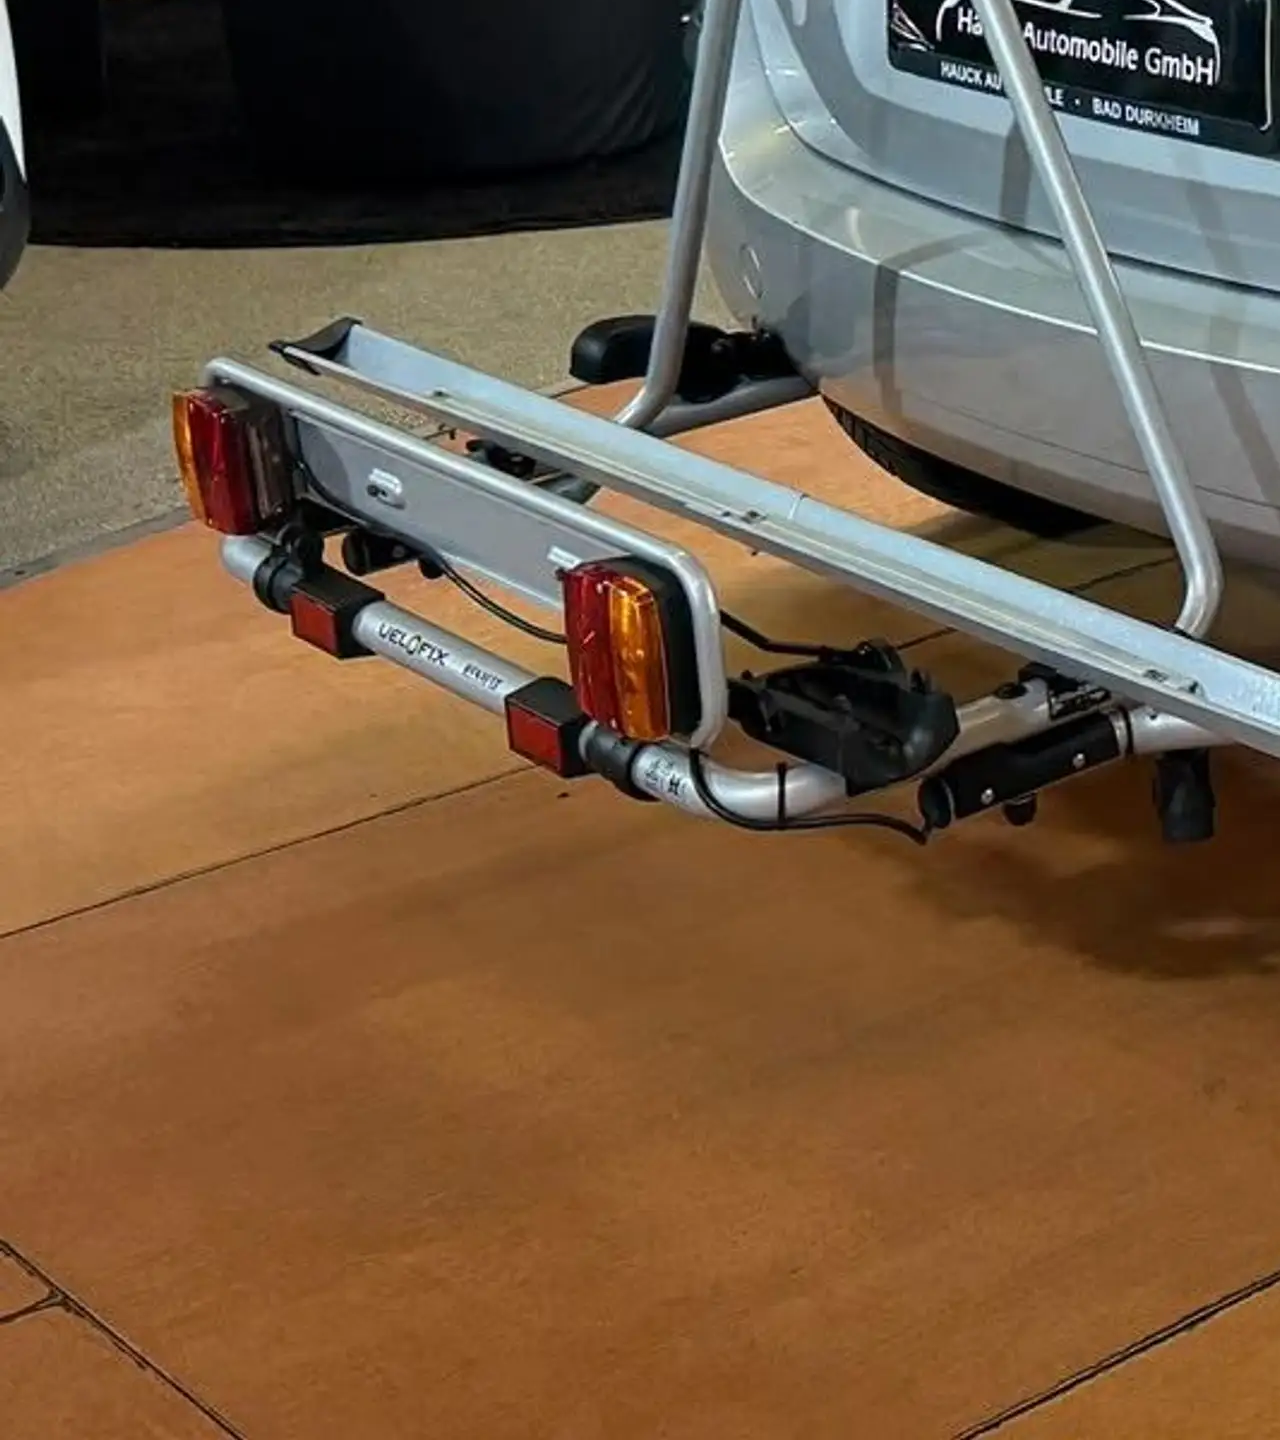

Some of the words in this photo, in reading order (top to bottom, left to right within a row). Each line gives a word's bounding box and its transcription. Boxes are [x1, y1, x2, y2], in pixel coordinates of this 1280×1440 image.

[1022, 21, 1139, 70] Automobile
[1145, 47, 1215, 86] GmbH
[1092, 97, 1122, 121] BAD
